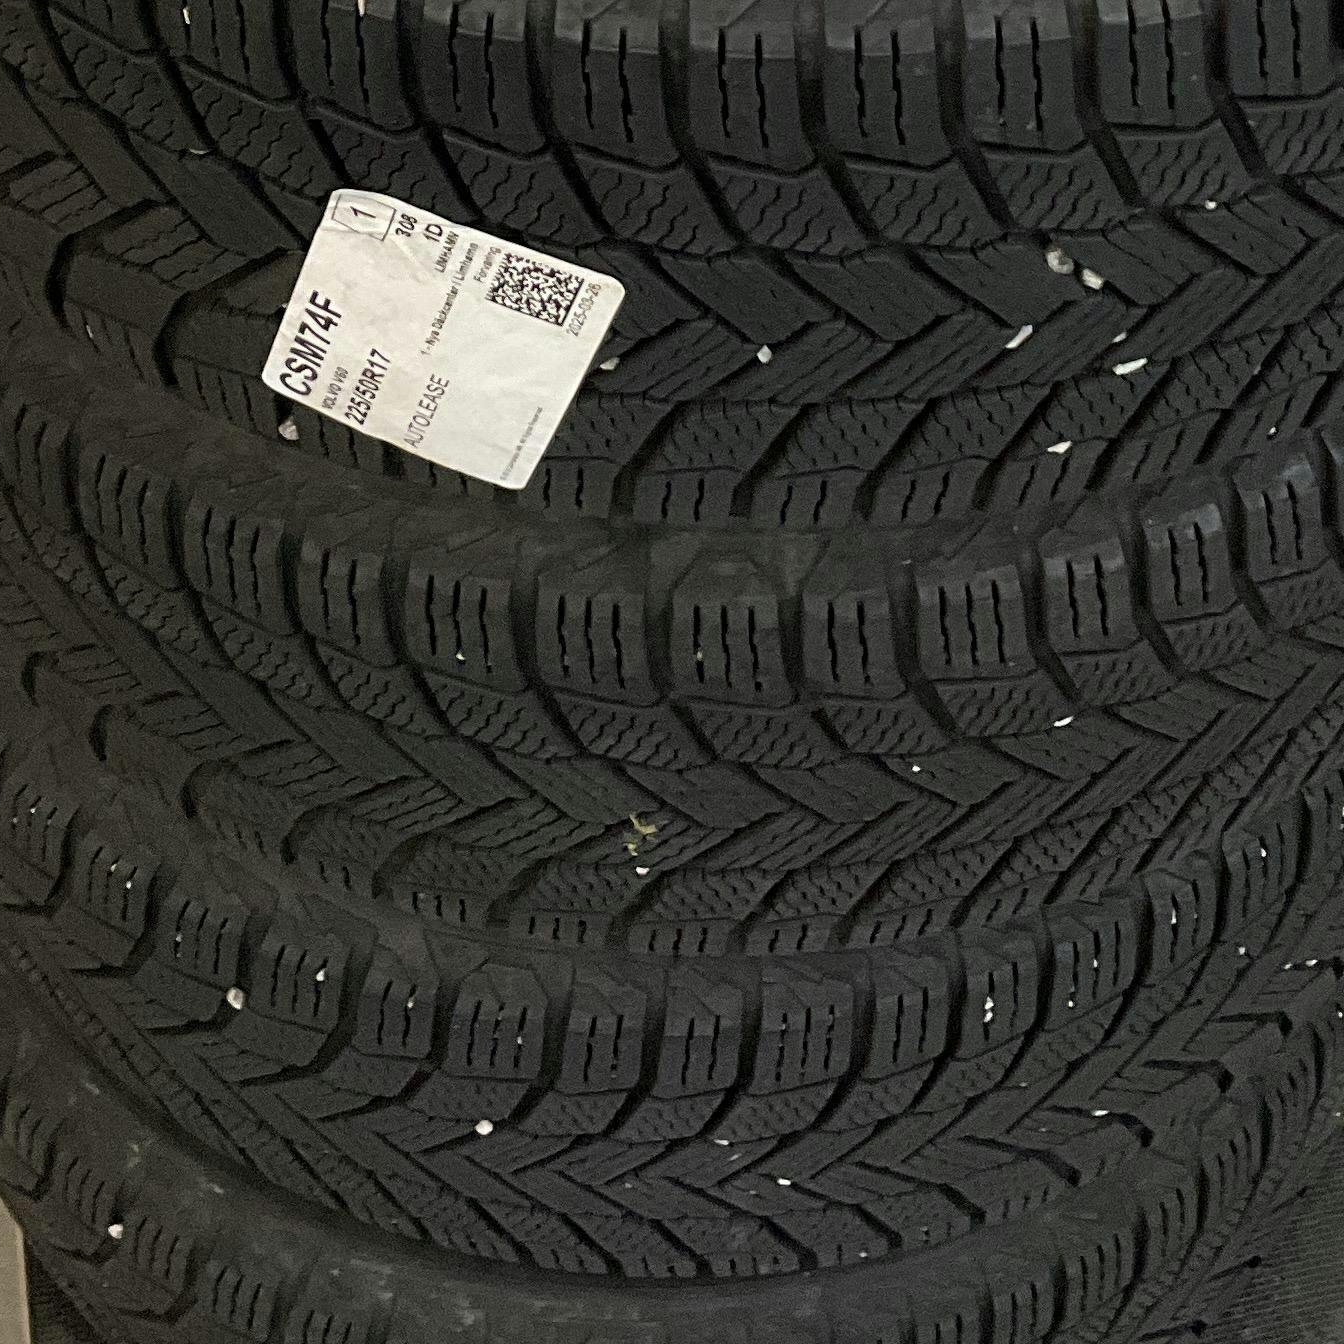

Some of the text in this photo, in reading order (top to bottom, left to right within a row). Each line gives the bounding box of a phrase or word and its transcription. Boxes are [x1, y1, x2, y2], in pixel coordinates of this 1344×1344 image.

[349, 205, 376, 219] 1
[394, 212, 418, 238] 308
[422, 222, 443, 243] 1D
[278, 289, 342, 396] CSM74F
[320, 365, 349, 410] VOLVO V60
[343, 347, 391, 426] 225/50R17
[402, 372, 450, 448] AUTOLEASE
